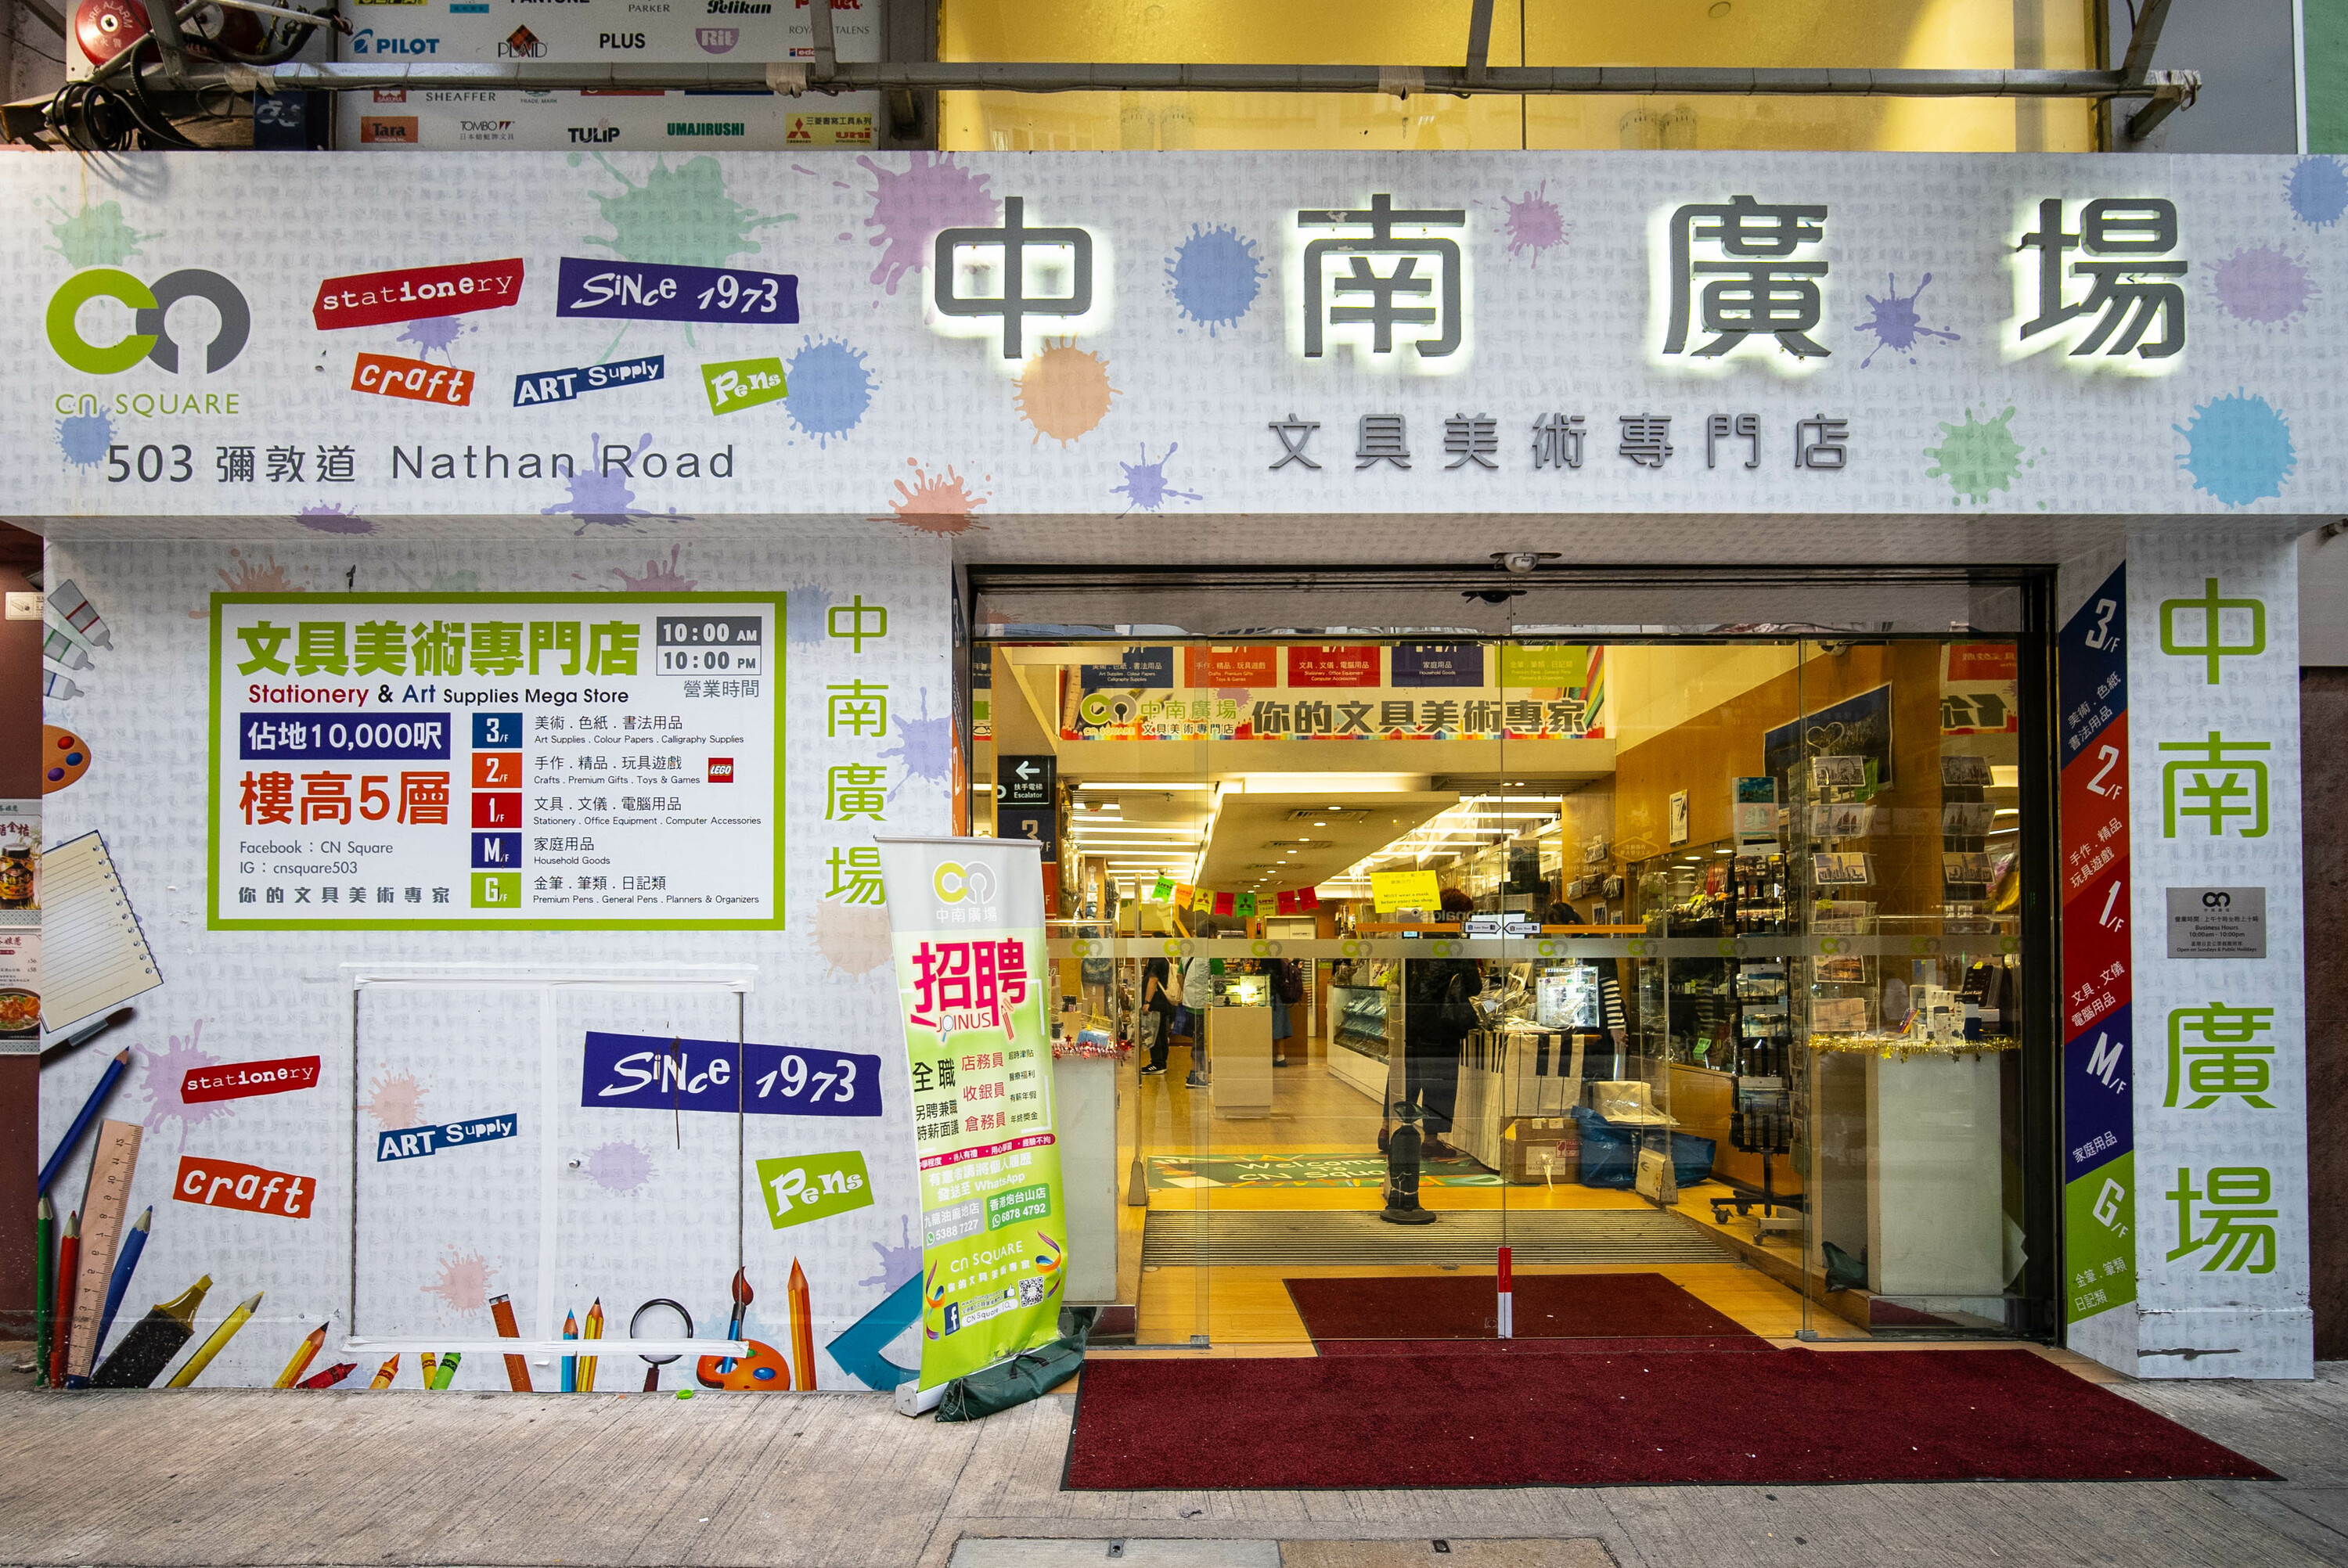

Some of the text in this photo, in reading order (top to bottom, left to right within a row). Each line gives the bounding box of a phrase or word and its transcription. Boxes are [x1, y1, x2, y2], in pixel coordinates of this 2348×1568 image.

[600, 33, 645, 49] PLUS
[702, 31, 734, 45] Rit
[835, 26, 870, 34] TALENS
[376, 38, 439, 55] PILOT
[427, 92, 495, 101] SHEAFFER
[373, 123, 405, 137] Tara
[460, 120, 497, 131] TOMBO
[668, 123, 744, 135] UMAJIRUSHI
[836, 128, 870, 138] uni
[322, 269, 513, 311] stationery
[934, 195, 2189, 361] 中南廣場
[697, 275, 778, 313] 1973
[358, 361, 466, 404] craft
[516, 372, 579, 405] ART
[708, 367, 783, 407] Pens
[116, 393, 239, 419] SQUARE
[1268, 412, 1849, 473] 文具美術專門店
[106, 441, 736, 482] 503 彌敦道 Nathan Road
[736, 630, 757, 641] AM
[2085, 598, 2120, 653] 3/F
[237, 620, 640, 677] 文具美術專門店
[738, 658, 755, 668] PM
[249, 685, 628, 707] Stationery & Art Supplies Mega Store
[684, 680, 758, 698] 營業時間
[1140, 699, 1237, 720] 中南廣場
[1252, 699, 1586, 735] 你的文具美術專家
[487, 718, 508, 742] 3/F
[535, 716, 682, 730] 美術 色紙 書法用品
[1143, 723, 1235, 735] 文具美術專門店
[2068, 704, 2113, 751] 書法用品
[248, 721, 441, 750] 佔地10,000呎
[551, 735, 585, 744] Supplies
[625, 735, 654, 744] Papers
[661, 735, 706, 744] Calligraphy
[710, 735, 744, 744] Supplies
[825, 595, 889, 905] 中南廣場
[486, 758, 507, 782] 2/F
[535, 756, 682, 770] 手作 精品 玩具遊戲
[709, 764, 732, 776] LEGO
[2087, 744, 2122, 800] 2/F
[637, 776, 657, 785] Toys
[239, 771, 449, 825] 樓高5層
[489, 798, 504, 822] 1/F
[535, 797, 681, 811] 文具 文儀 電腦用品
[534, 817, 575, 825] Stationery
[613, 817, 657, 825] Equipment
[666, 817, 708, 825] Computer
[321, 841, 340, 853] CN
[348, 841, 393, 856] Square
[535, 836, 594, 851] 家庭用品
[274, 861, 357, 876] cnsquare503
[239, 887, 449, 903] 你的文具美術專家
[484, 876, 508, 902] G/F
[535, 876, 665, 890] 金筆 筆類 日記類
[715, 895, 759, 904] Organizers
[2099, 879, 2124, 933] 1/F
[936, 907, 998, 923] 中南廣場
[2159, 577, 2278, 1274] 中南廣場
[910, 937, 1028, 1027] 招聘
[2071, 983, 2094, 1006] 文具
[2071, 992, 2116, 1027] 電腦用品
[961, 1052, 1003, 1071] 店務員
[2087, 1031, 2127, 1094] M/F
[185, 1063, 316, 1093] stationery
[756, 1053, 859, 1102] 1973
[913, 1058, 956, 1092] 全職
[963, 1081, 1005, 1102] 收銀員
[964, 1112, 1006, 1132] 倉務員
[378, 1128, 434, 1161] ART
[2073, 1130, 2117, 1163] 家庭用品
[1235, 1159, 1387, 1170] Welcome
[181, 1165, 308, 1217] craft
[769, 1168, 866, 1219] Pens
[974, 1173, 1025, 1192] WhatsApp
[989, 1187, 1046, 1211] 香港炮台山店
[2092, 1177, 2129, 1239] G/F
[924, 1203, 979, 1228] 九龍油麻地店
[1001, 1203, 1046, 1222] 6878 4792
[936, 1219, 979, 1240] 5388 7227
[973, 1241, 1023, 1266] SQUARE
[2075, 1289, 2108, 1313] 日記類
